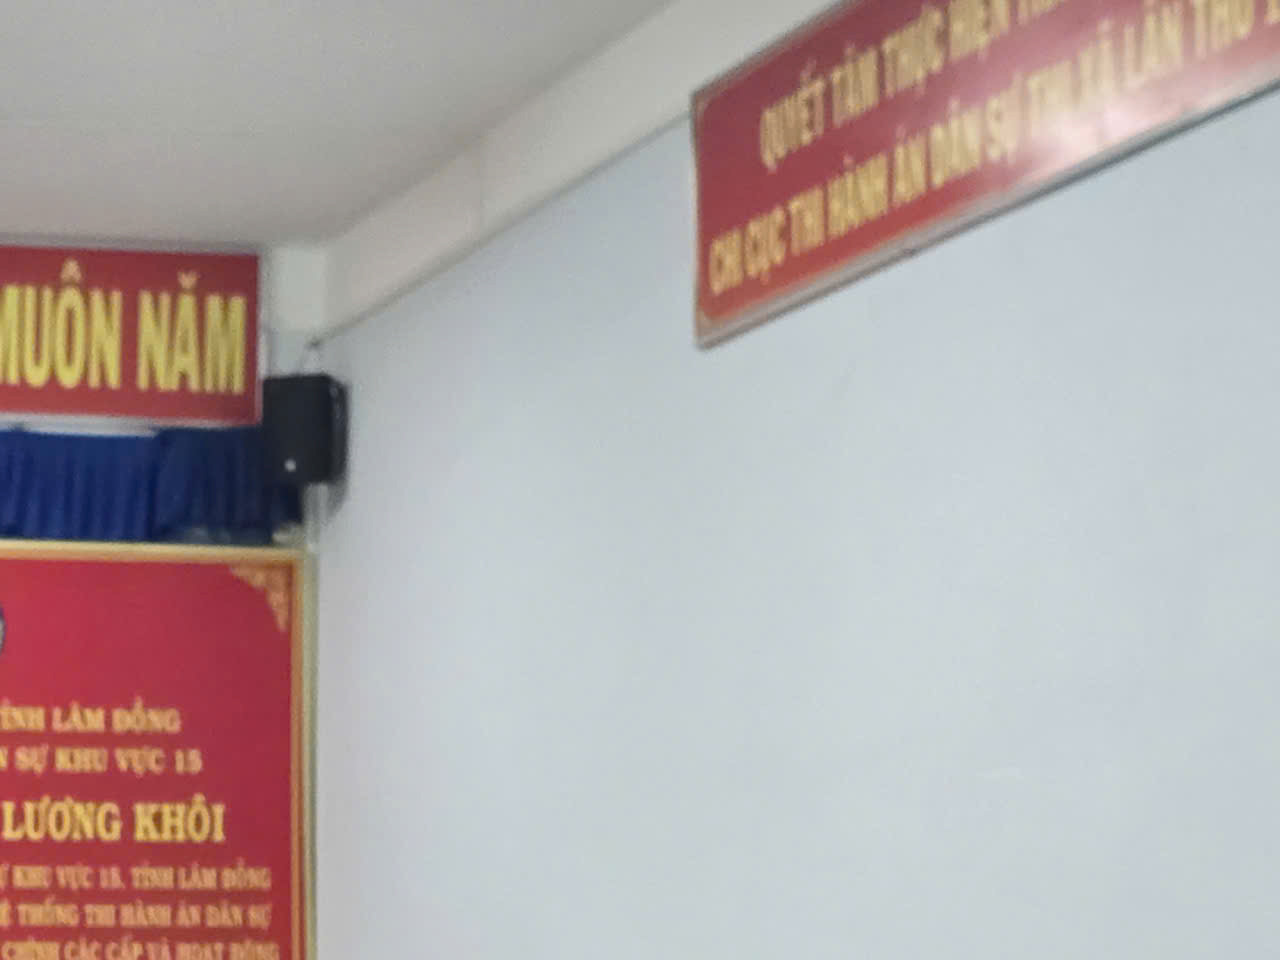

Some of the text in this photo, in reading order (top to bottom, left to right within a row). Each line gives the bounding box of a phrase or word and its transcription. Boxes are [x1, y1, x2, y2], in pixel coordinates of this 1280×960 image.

[137, 270, 248, 394] NĂM
[51, 700, 105, 733] LÂM
[111, 696, 181, 734] ĐỒNG
[14, 743, 49, 776] SỰ
[54, 746, 109, 773] KHU
[114, 746, 166, 778] VỰC
[1, 794, 122, 841] LƯƠNG
[133, 791, 226, 842] KHÔI
